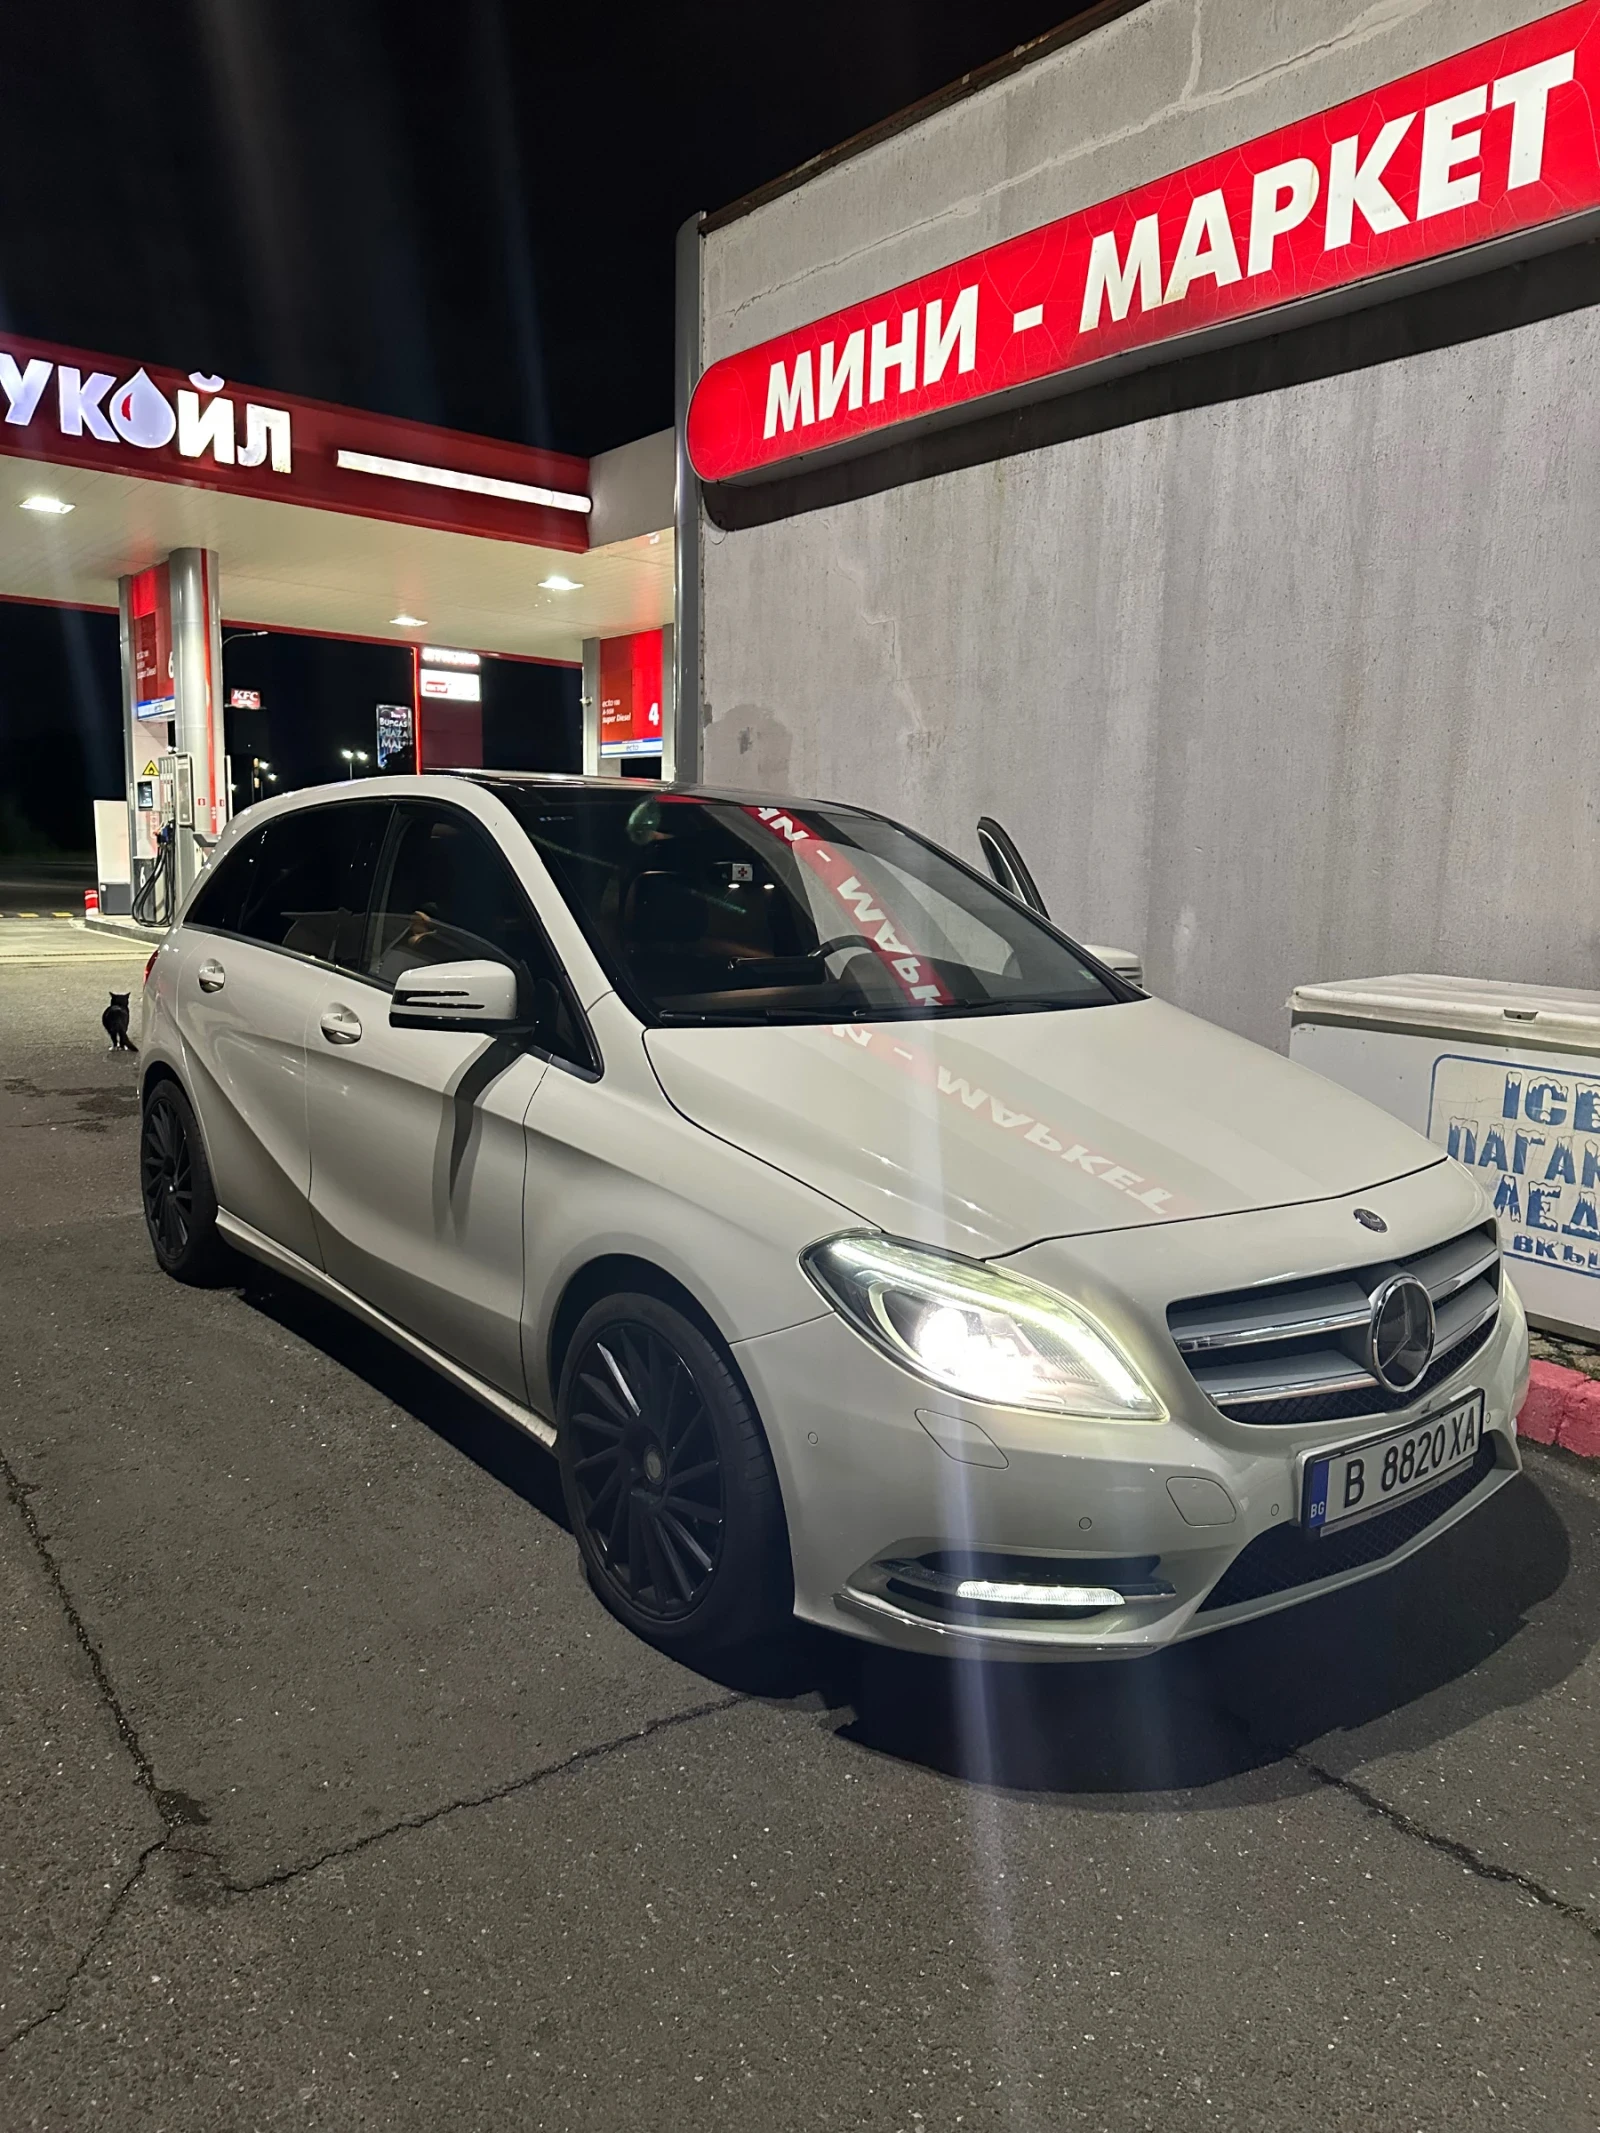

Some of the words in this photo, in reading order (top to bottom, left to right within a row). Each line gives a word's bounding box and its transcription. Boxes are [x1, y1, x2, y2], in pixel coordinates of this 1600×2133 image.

[763, 285, 979, 440] МИНИ
[1012, 302, 1043, 334] -
[1078, 50, 1576, 334] МАРКЕТ
[232, 690, 259, 702] KFC
[379, 717, 408, 728] BURGAS
[616, 712, 631, 722] Diesel
[648, 702, 660, 726] 4
[379, 726, 409, 738] PLAZA
[381, 738, 406, 749] MAL
[139, 867, 147, 888] 6
[1502, 1071, 1600, 1134] ICE
[1344, 1458, 1365, 1508] B
[1381, 1424, 1446, 1492] 8820
[1449, 1406, 1475, 1461] XA
[1310, 1501, 1325, 1519] BG
